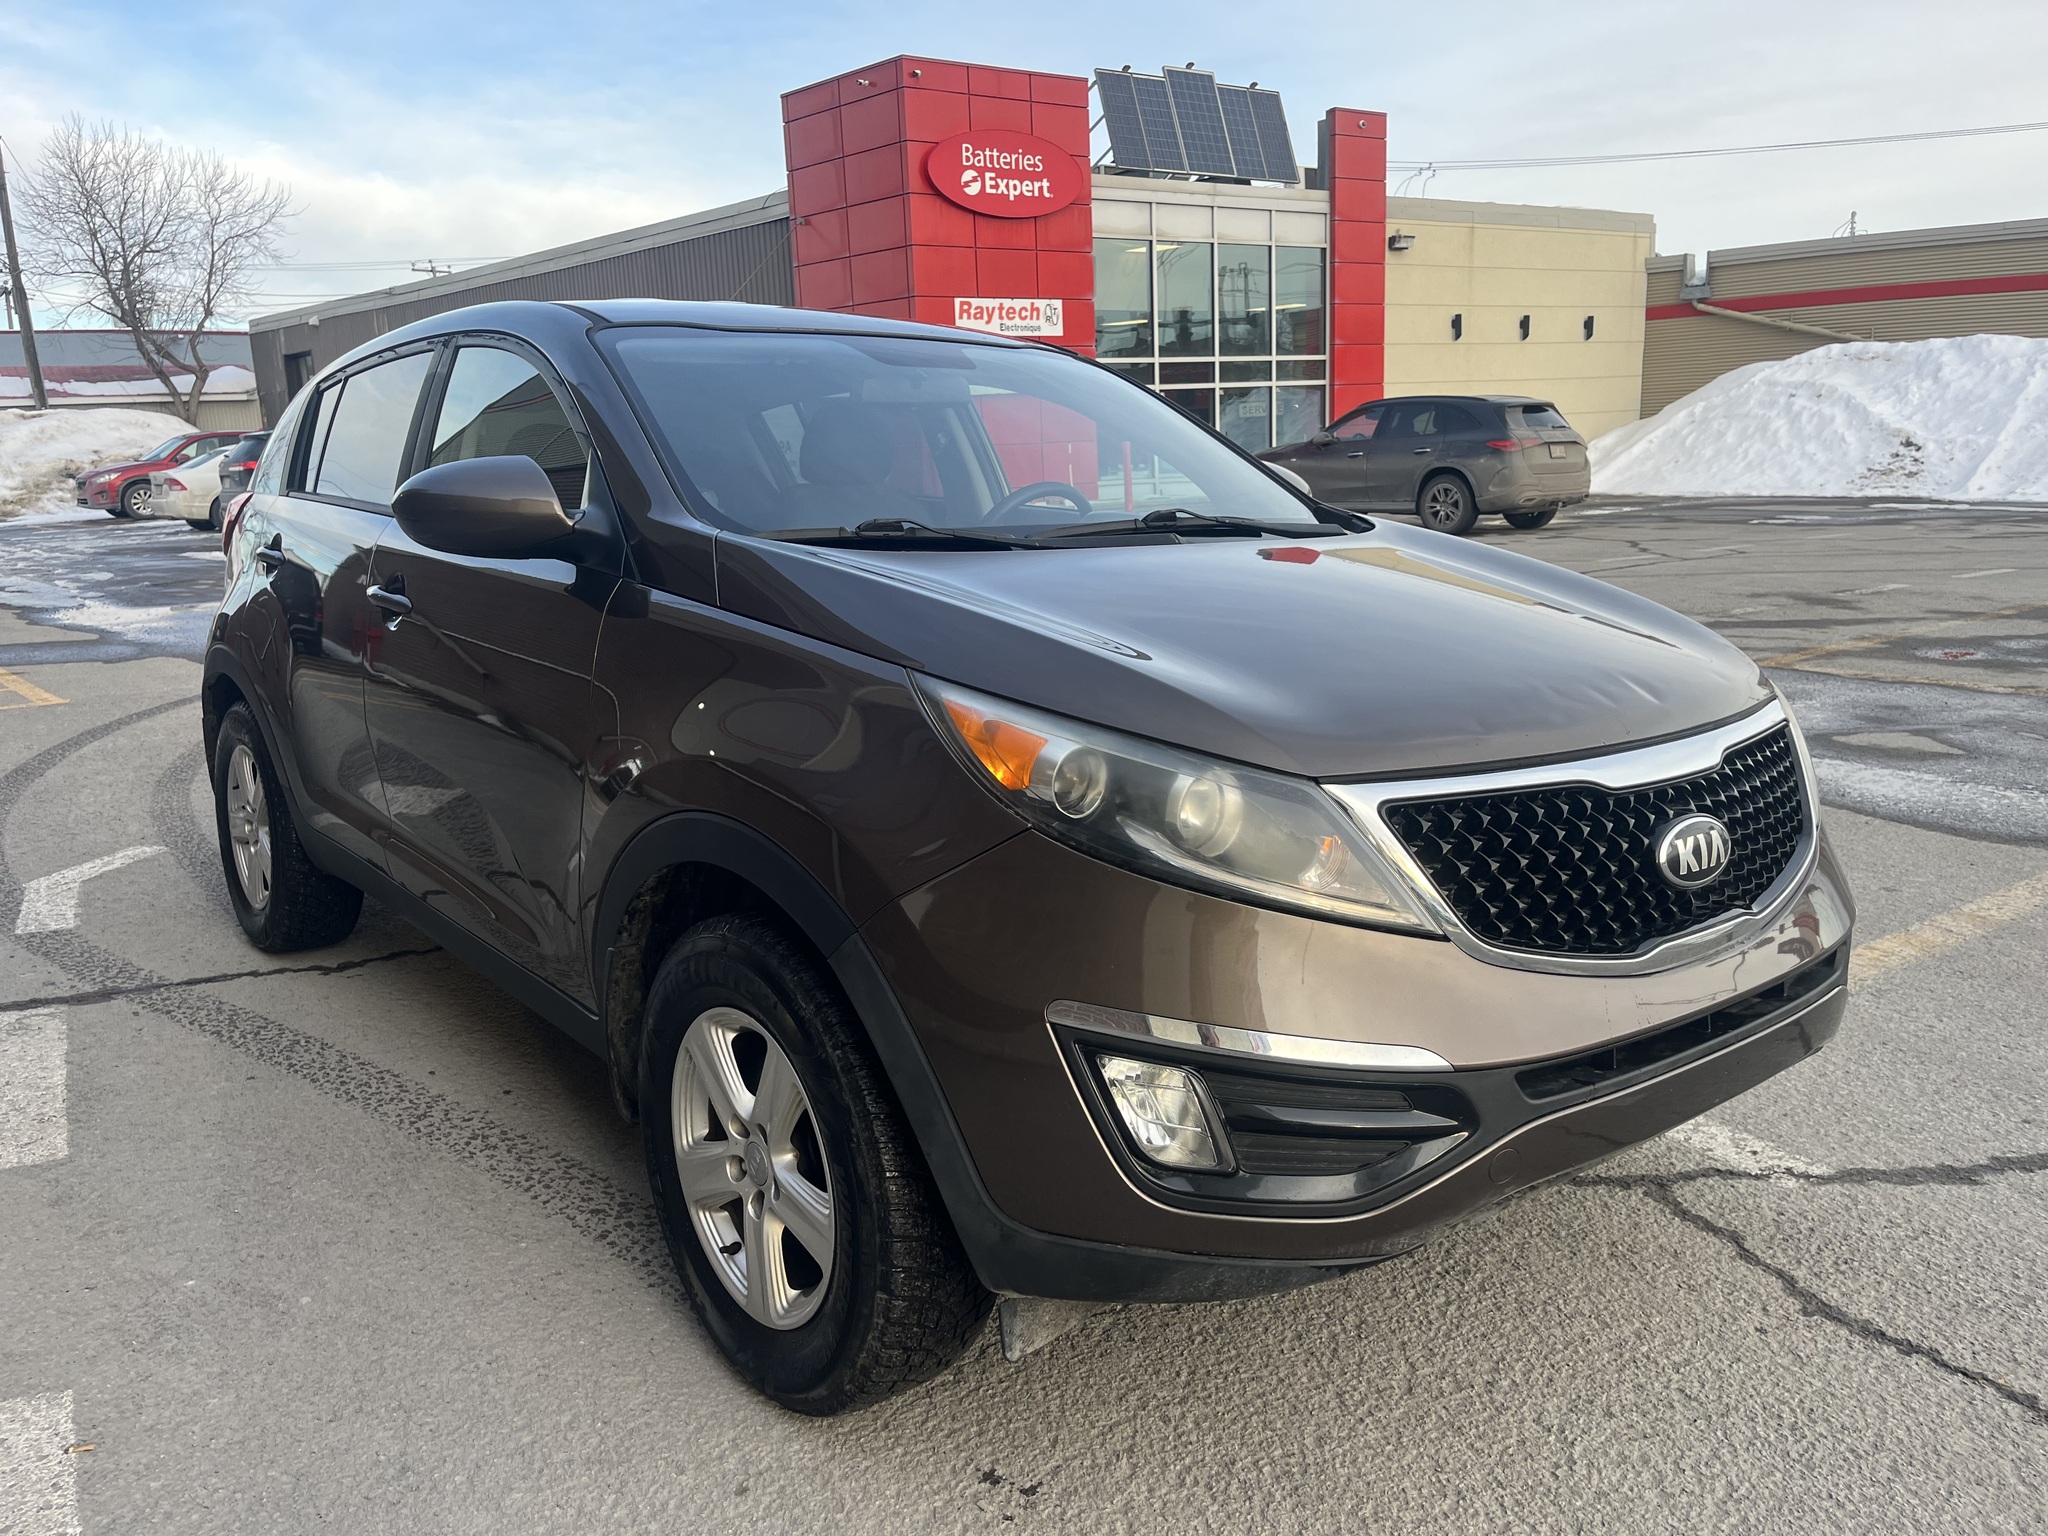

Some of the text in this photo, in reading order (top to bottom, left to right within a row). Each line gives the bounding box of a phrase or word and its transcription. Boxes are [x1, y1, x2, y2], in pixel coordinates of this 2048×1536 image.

[961, 143, 1043, 172] Batteries
[985, 172, 1051, 201] Expert
[958, 301, 1041, 325] Raytech
[1674, 829, 1726, 876] KIA
